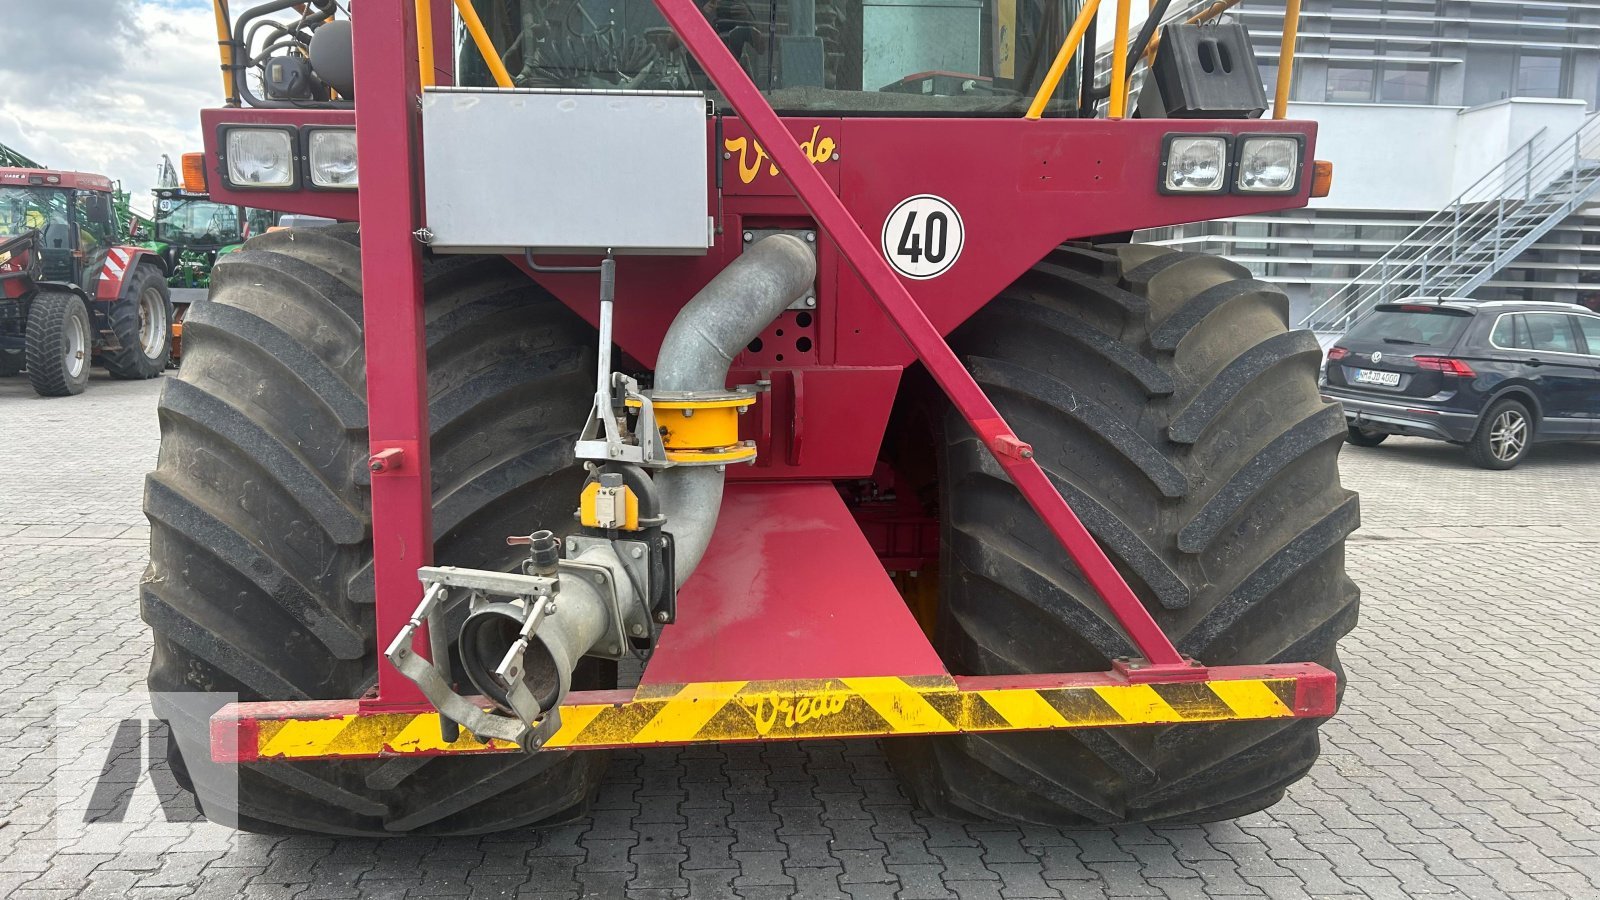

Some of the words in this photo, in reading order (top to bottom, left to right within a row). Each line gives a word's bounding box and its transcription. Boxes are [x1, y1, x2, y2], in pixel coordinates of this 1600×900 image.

[725, 125, 836, 184] Vdo
[897, 210, 948, 264] 40
[741, 682, 849, 735] Vredo
